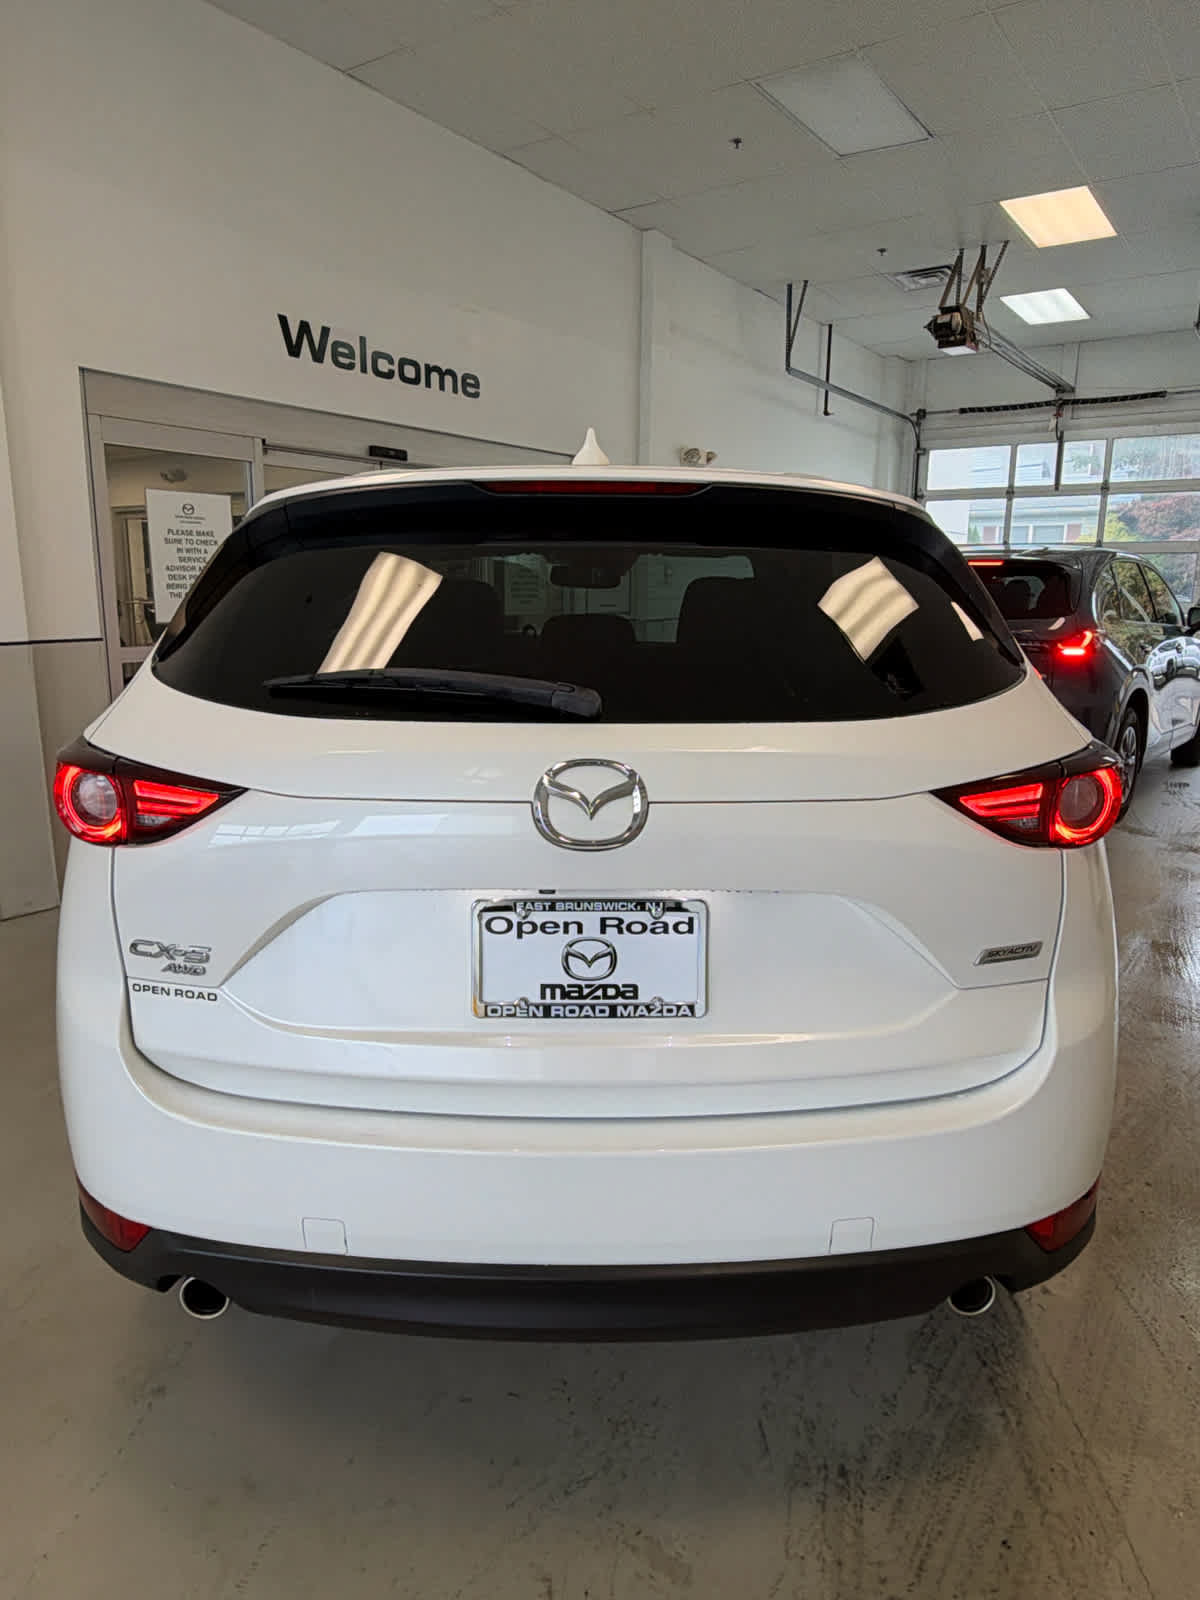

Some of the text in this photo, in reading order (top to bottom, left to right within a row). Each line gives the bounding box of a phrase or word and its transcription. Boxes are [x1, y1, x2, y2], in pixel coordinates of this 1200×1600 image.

[277, 313, 481, 399] Welcome
[167, 528, 215, 538] PLEASE MAKE
[164, 537, 219, 546] SURE TO CHECK
[185, 547, 202, 555] WITH
[178, 556, 208, 564] SERVICE
[165, 564, 197, 572] ADVISOR
[167, 573, 188, 582] DESK
[166, 582, 188, 591] BEING
[169, 591, 183, 600] THE
[516, 902, 551, 912] EAST
[485, 916, 694, 939] Open Road
[129, 939, 212, 963] CX-5
[161, 963, 207, 976] AWD
[132, 983, 218, 1002] OPEN ROAD
[487, 1005, 692, 1018] OPEN ROAD MAZDA
